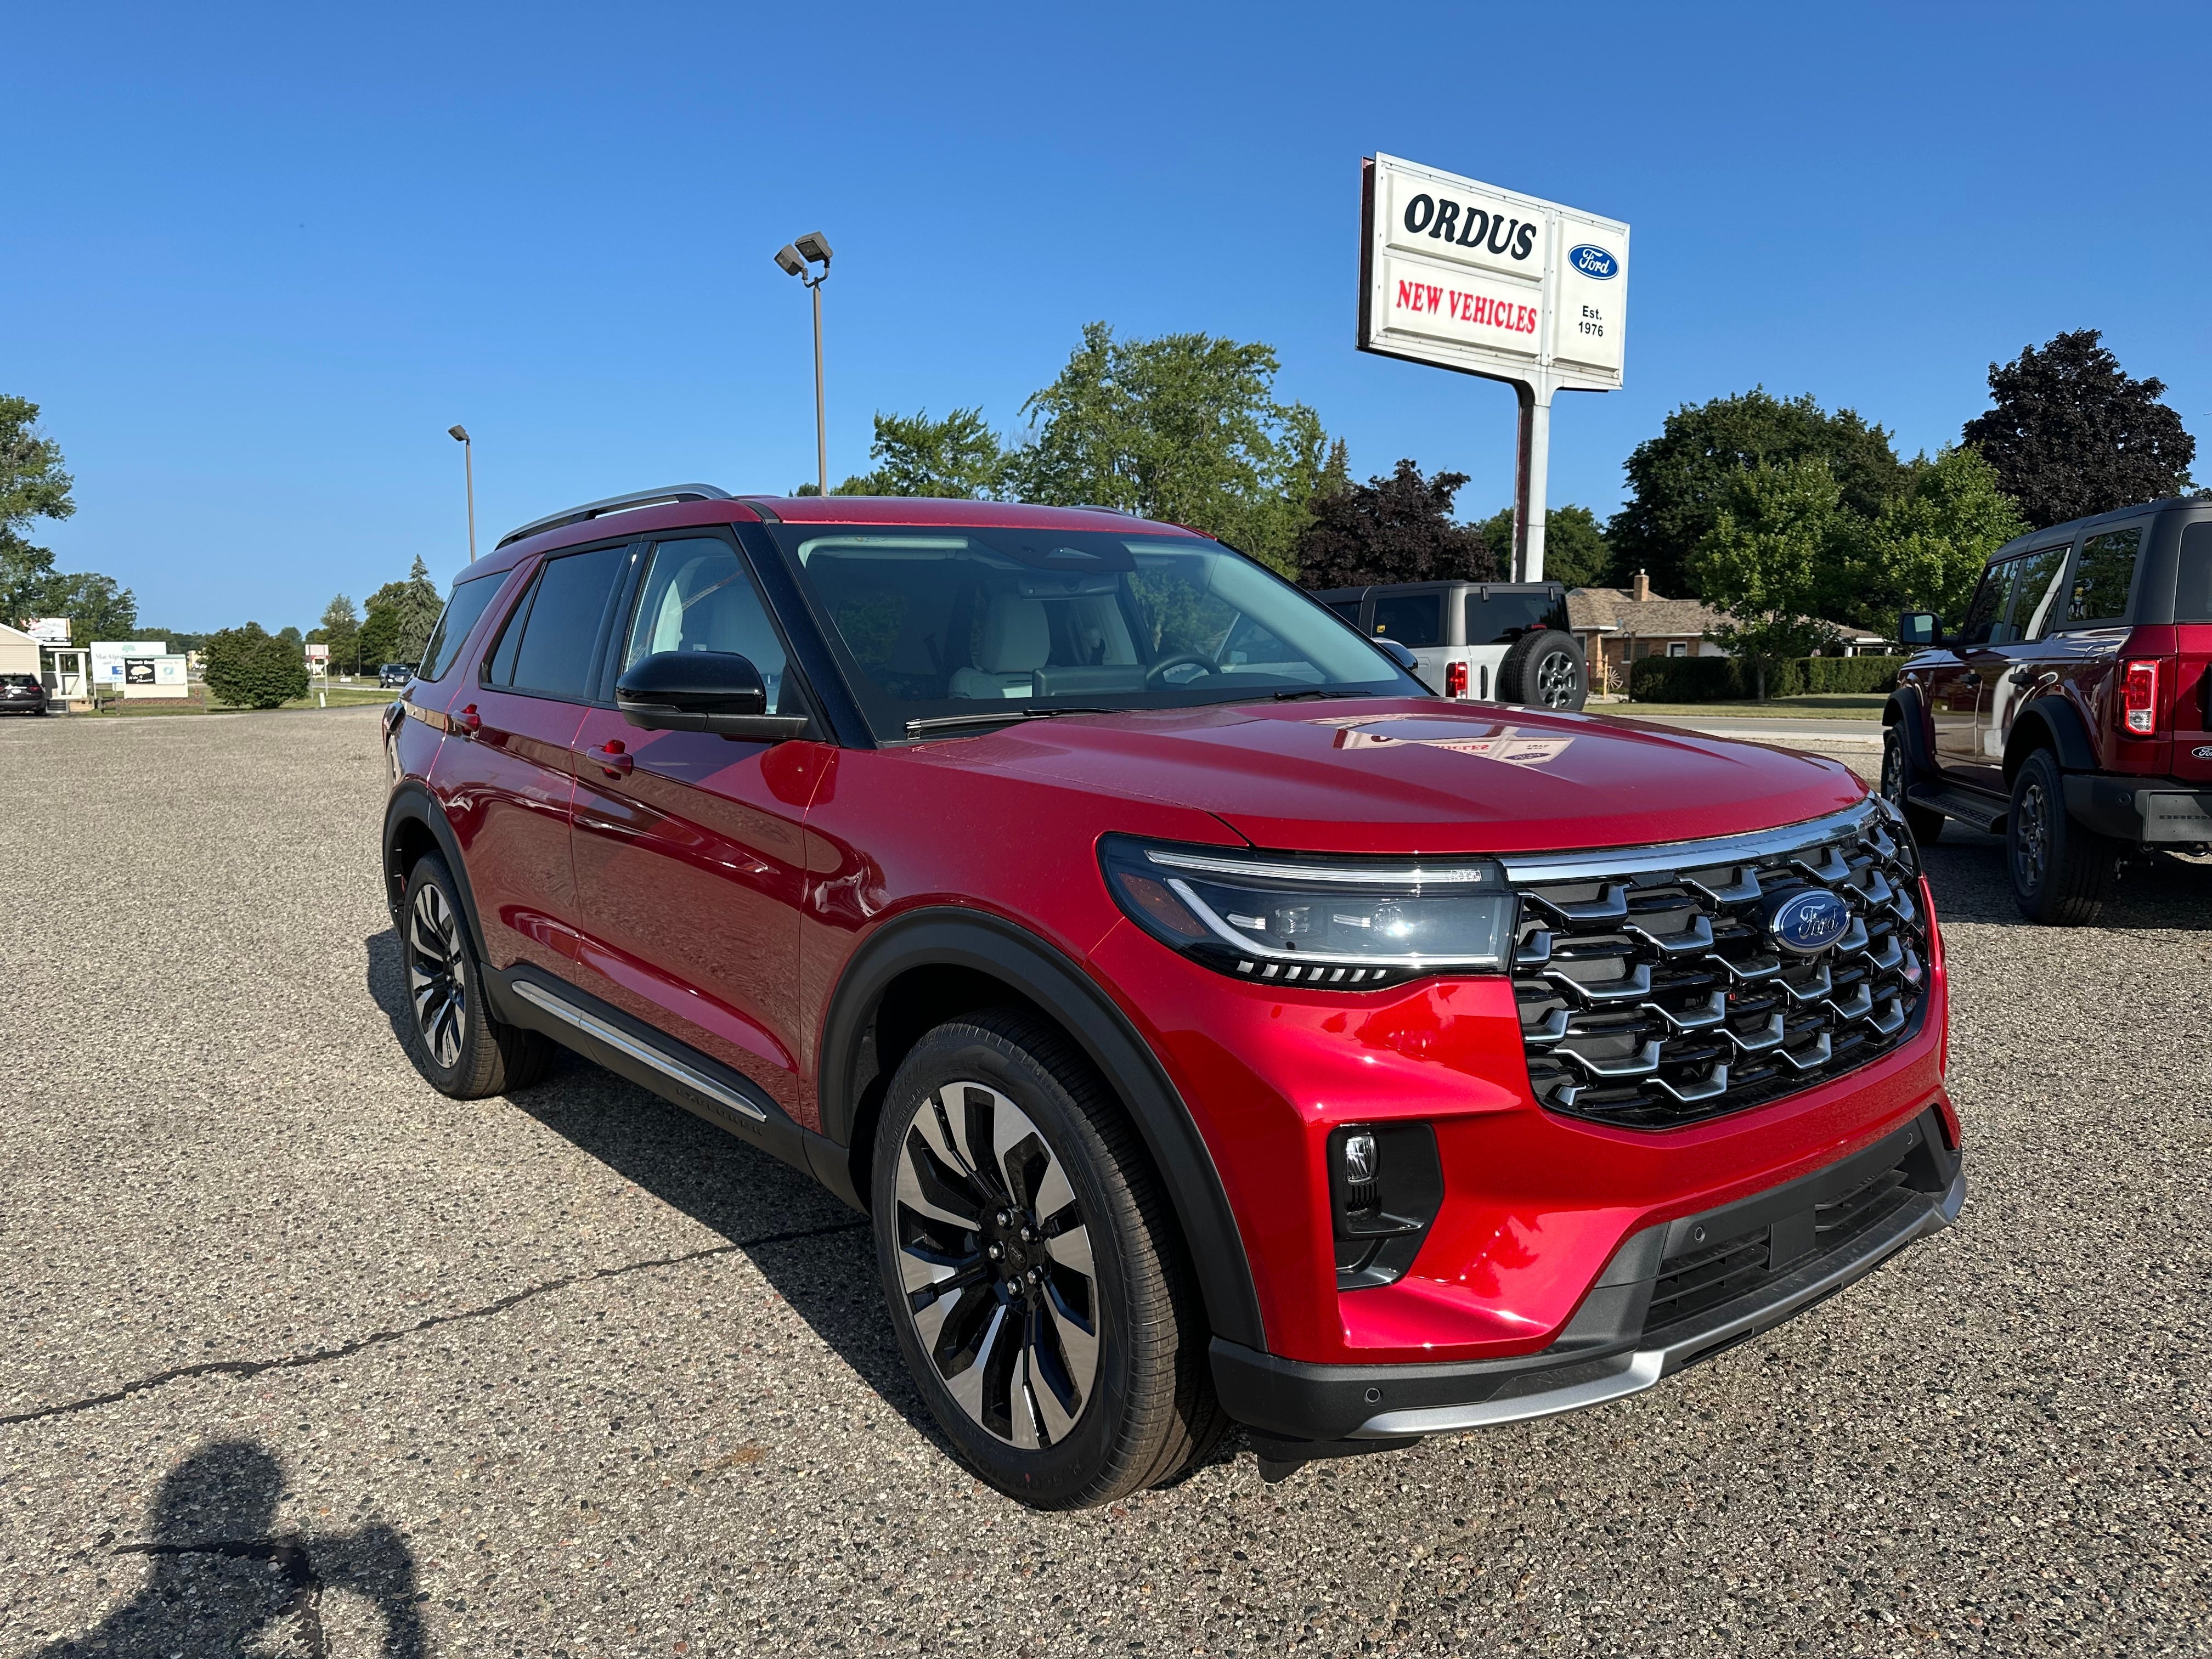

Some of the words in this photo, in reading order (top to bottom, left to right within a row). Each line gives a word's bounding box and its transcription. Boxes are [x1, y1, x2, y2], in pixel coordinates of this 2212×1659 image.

[1404, 194, 1537, 261] ORDUS
[1579, 249, 1610, 274] Ford
[1396, 280, 1443, 315] NEW
[1449, 290, 1537, 334] VEHICLES
[1582, 305, 1602, 320] Est.
[1578, 321, 1604, 337] 1976
[1799, 904, 1839, 939] Ford
[676, 1088, 764, 1136] EXPLORER
